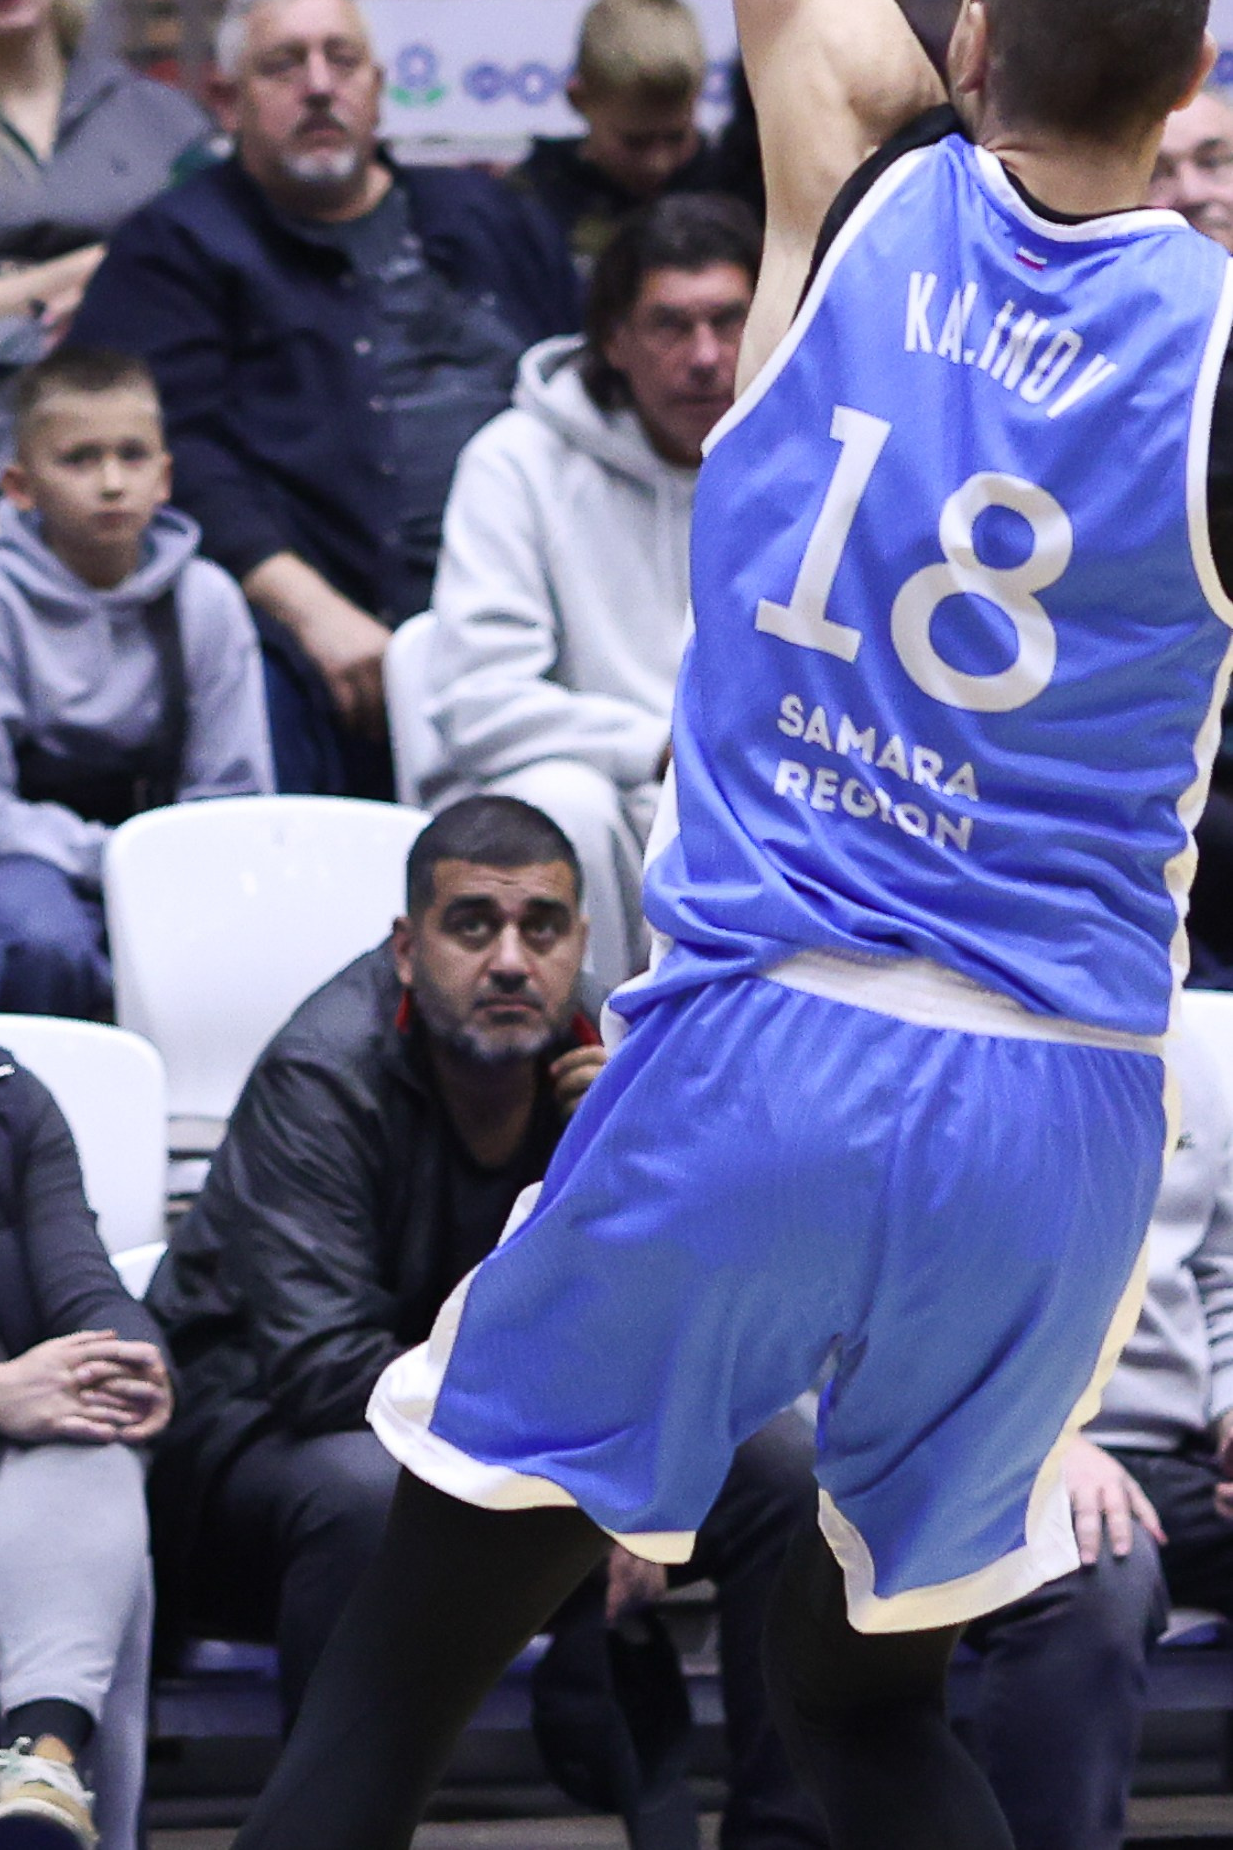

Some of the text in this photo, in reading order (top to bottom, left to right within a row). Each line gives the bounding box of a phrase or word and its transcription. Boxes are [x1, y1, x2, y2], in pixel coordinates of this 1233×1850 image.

[904, 271, 1118, 419] KALINOV
[755, 405, 1073, 713] 18
[774, 759, 974, 852] REGION
[777, 695, 979, 802] SAMARA
